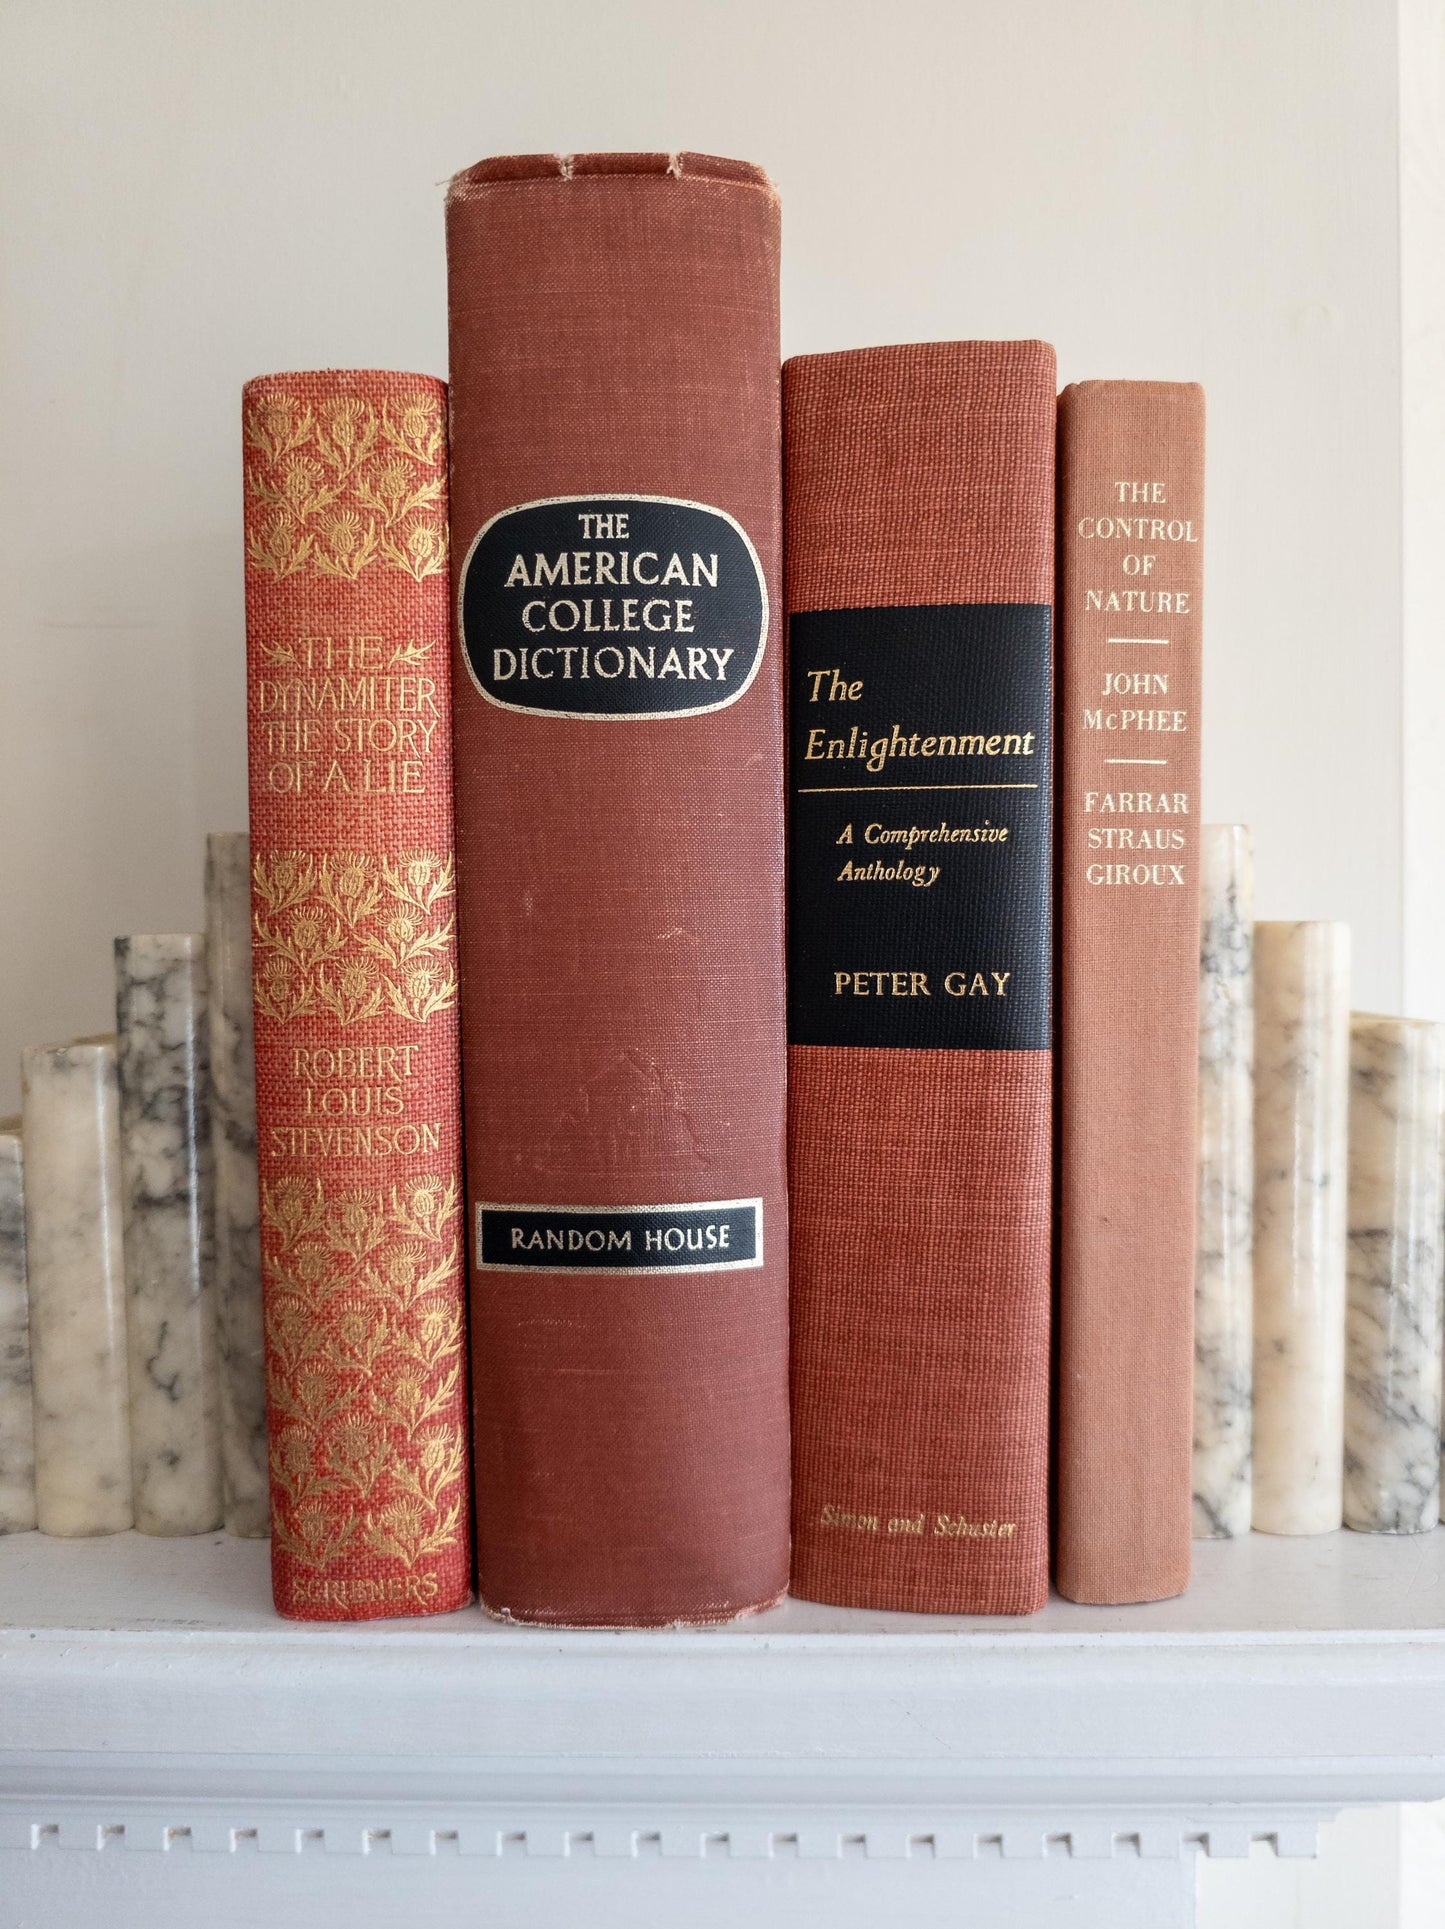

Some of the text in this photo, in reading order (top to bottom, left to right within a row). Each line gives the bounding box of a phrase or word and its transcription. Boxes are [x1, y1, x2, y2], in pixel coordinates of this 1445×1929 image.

[1114, 481, 1167, 503] THE
[579, 513, 629, 539] THE
[1078, 517, 1199, 543] CONTROL
[504, 552, 719, 587] AMERICAN
[1123, 554, 1156, 576] OF
[521, 599, 695, 633] COLLEGE
[1085, 590, 1190, 614] NATURE
[299, 636, 383, 670] THE
[493, 646, 735, 681] DICTIONARY
[259, 676, 441, 718] DYNAMITER
[807, 669, 864, 703] The
[1102, 673, 1169, 696] JOHN
[1083, 708, 1187, 732] McPHEE
[261, 718, 438, 758] THE STORY
[804, 725, 1036, 772] Enlightenment
[269, 759, 426, 794] OF A LIE
[1084, 791, 1189, 814] FARRAR
[836, 819, 1008, 850] A Comprehensive
[1087, 828, 1185, 850] STRAUS
[837, 860, 941, 887] Anthology
[1086, 864, 1185, 886] GIROUX
[834, 971, 1011, 997] PETER GAY
[293, 1045, 419, 1083] ROBERT
[304, 1086, 405, 1116] LOUIS
[271, 1123, 441, 1157] STEVENSON
[511, 1224, 731, 1251] RANDOM HOUSE
[821, 1504, 1017, 1537] Simon and Schuster
[292, 1571, 438, 1610] SCRIBNERS
